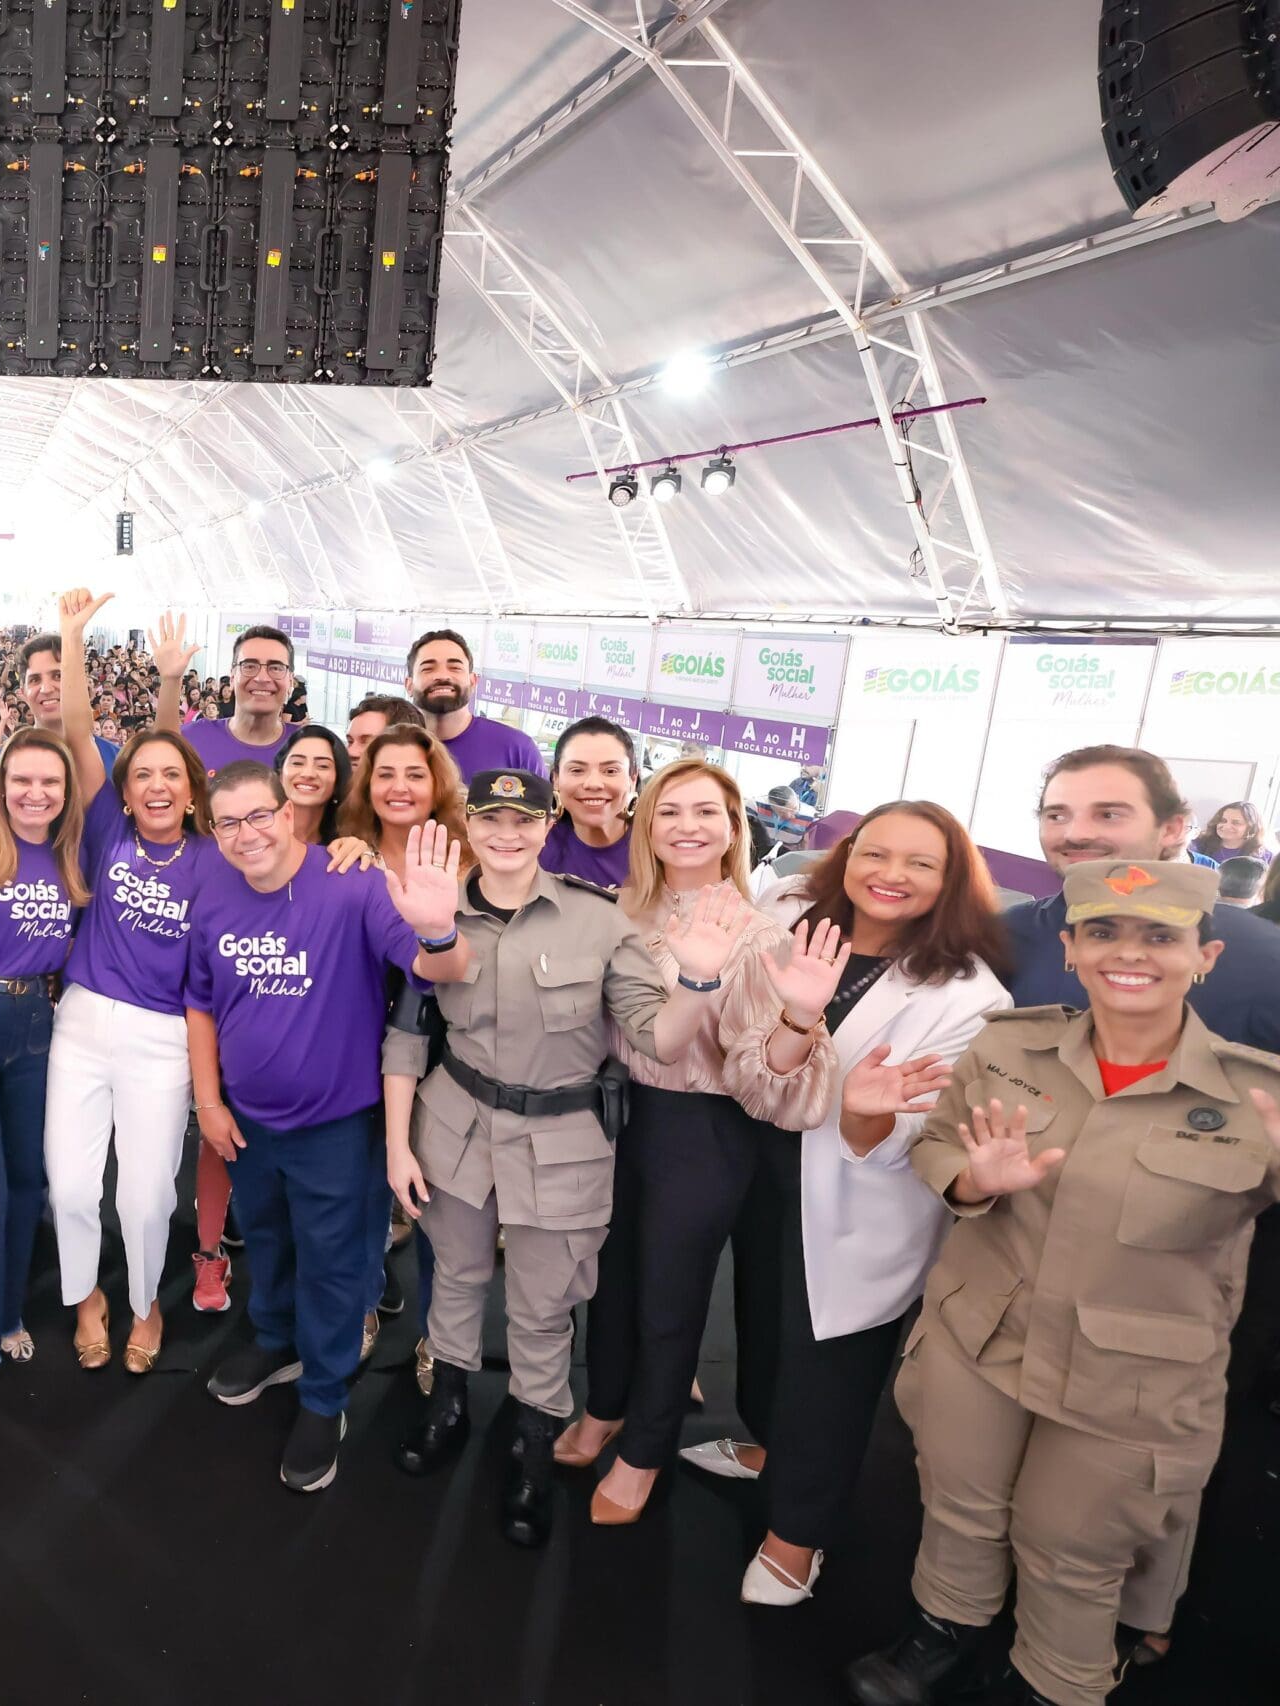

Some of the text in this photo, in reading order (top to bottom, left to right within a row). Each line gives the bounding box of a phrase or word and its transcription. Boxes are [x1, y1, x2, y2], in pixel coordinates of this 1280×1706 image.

[544, 641, 578, 661] GOIÁS
[600, 636, 628, 652] Goiás
[605, 650, 635, 665] social
[673, 652, 725, 678] GOIÁS
[759, 648, 803, 667] Goiás
[1036, 653, 1101, 673] Goiás
[767, 665, 815, 684] social
[887, 663, 981, 693] GOIÁS
[1048, 669, 1116, 689] social
[1193, 666, 1280, 695] GOIÁS
[485, 679, 491, 694] R
[505, 682, 513, 697] Z
[531, 687, 540, 702] M
[557, 691, 566, 707] Q
[769, 683, 812, 701] Mulher
[589, 694, 625, 715] K AO L
[660, 707, 700, 730] I AO J
[649, 725, 710, 742] TROCA DE CARTÃO
[742, 720, 806, 748] A AO H
[734, 741, 810, 761] TROCA DE CARTÃO
[108, 861, 171, 899] Goiás
[10, 900, 71, 920] social
[113, 885, 189, 921] social
[118, 907, 185, 939] Mulher
[219, 931, 287, 957] Goiás
[235, 951, 307, 976] social
[249, 976, 308, 1000] Mulher
[987, 1063, 1042, 1097] MAJ JOYCE
